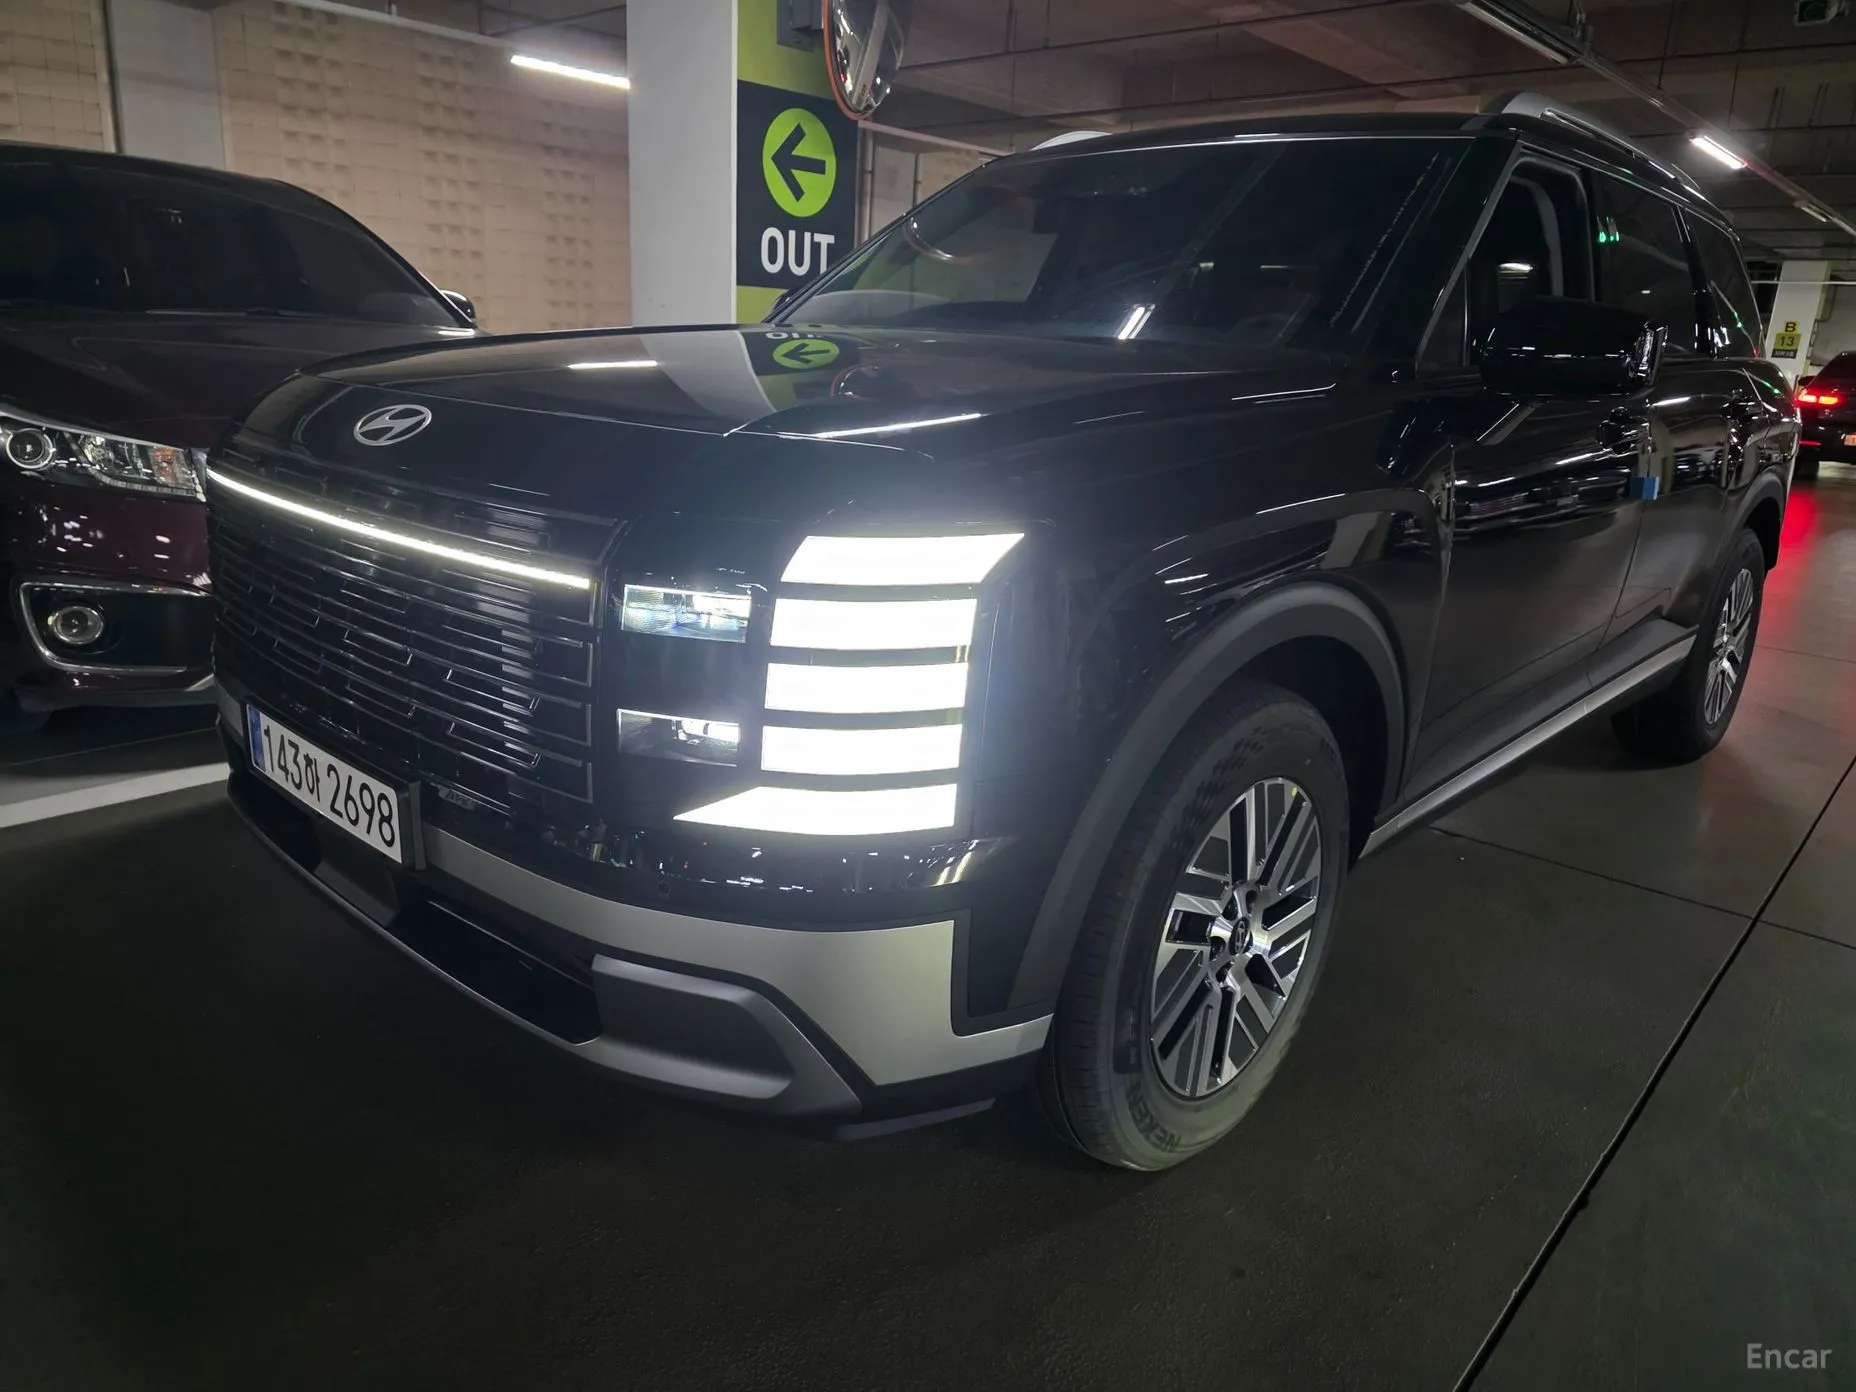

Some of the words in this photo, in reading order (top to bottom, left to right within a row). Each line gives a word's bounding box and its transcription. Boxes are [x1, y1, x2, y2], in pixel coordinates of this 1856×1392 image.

[760, 226, 835, 276] OUT
[1780, 336, 1795, 347] 13
[1785, 321, 1797, 333] B
[263, 724, 321, 803] 143하
[326, 763, 396, 848] 2698
